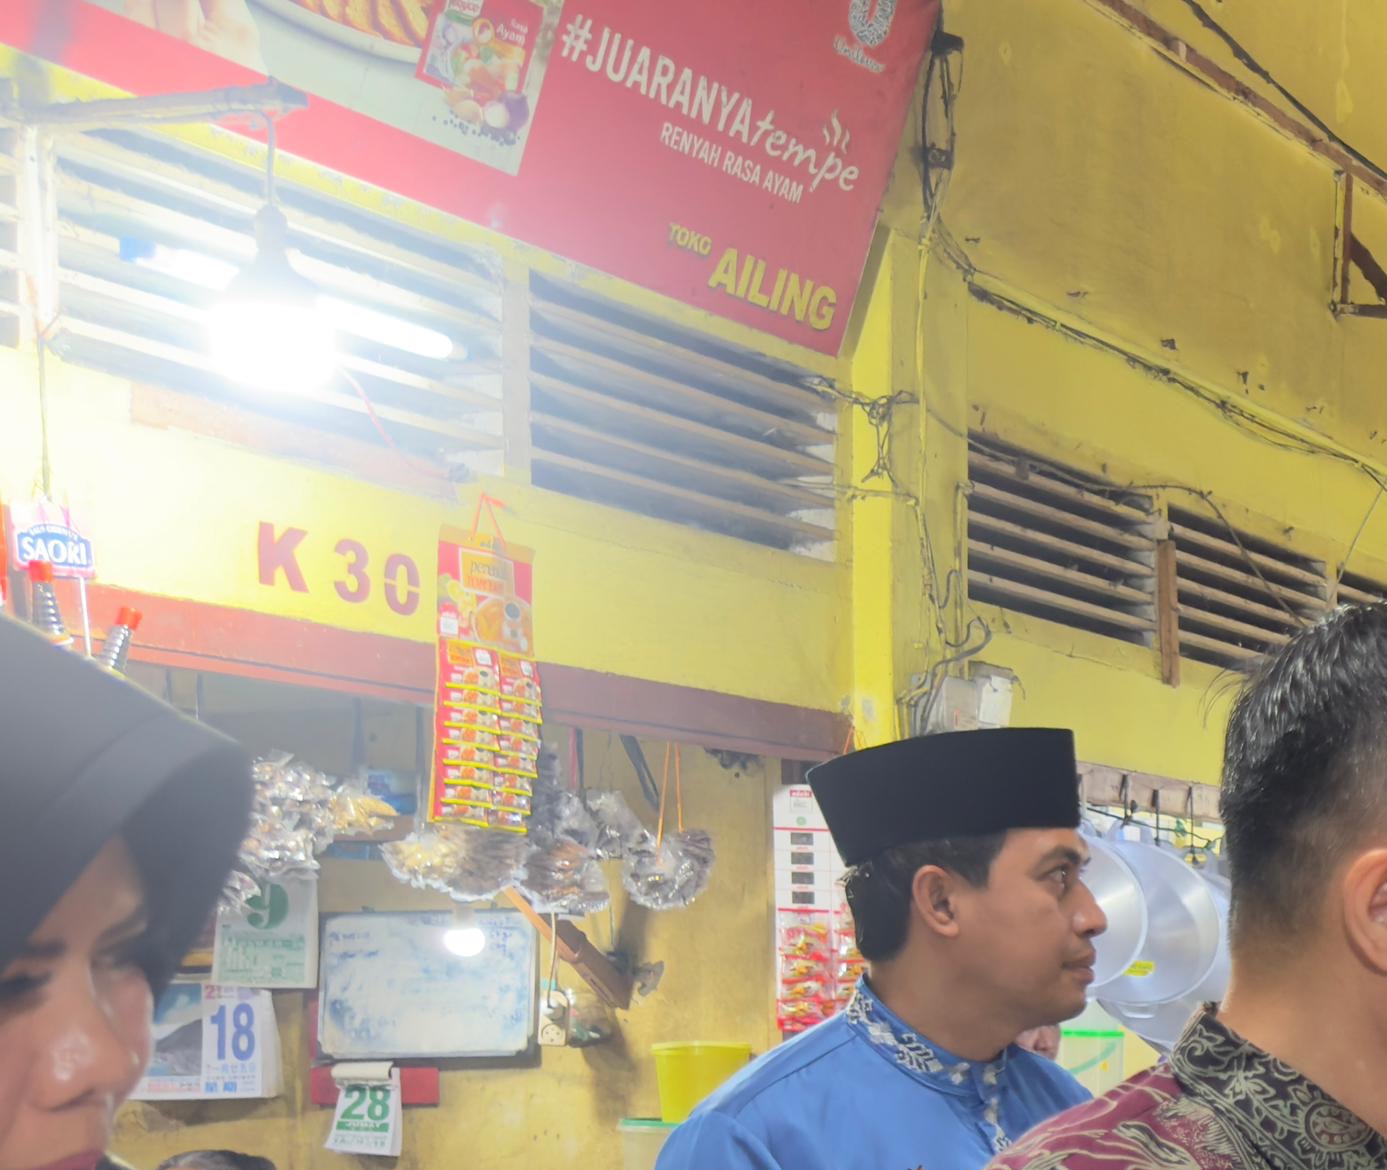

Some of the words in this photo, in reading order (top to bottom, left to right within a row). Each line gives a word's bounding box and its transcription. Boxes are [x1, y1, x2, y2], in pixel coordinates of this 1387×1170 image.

[659, 121, 721, 168] RENYAH
[724, 145, 763, 186] RASA
[762, 166, 804, 205] AYAM
[668, 223, 713, 257] TOKO
[708, 248, 838, 332] AILING
[22, 536, 87, 565] SAORI
[209, 1002, 257, 1062] 18
[339, 1083, 391, 1122] 28
